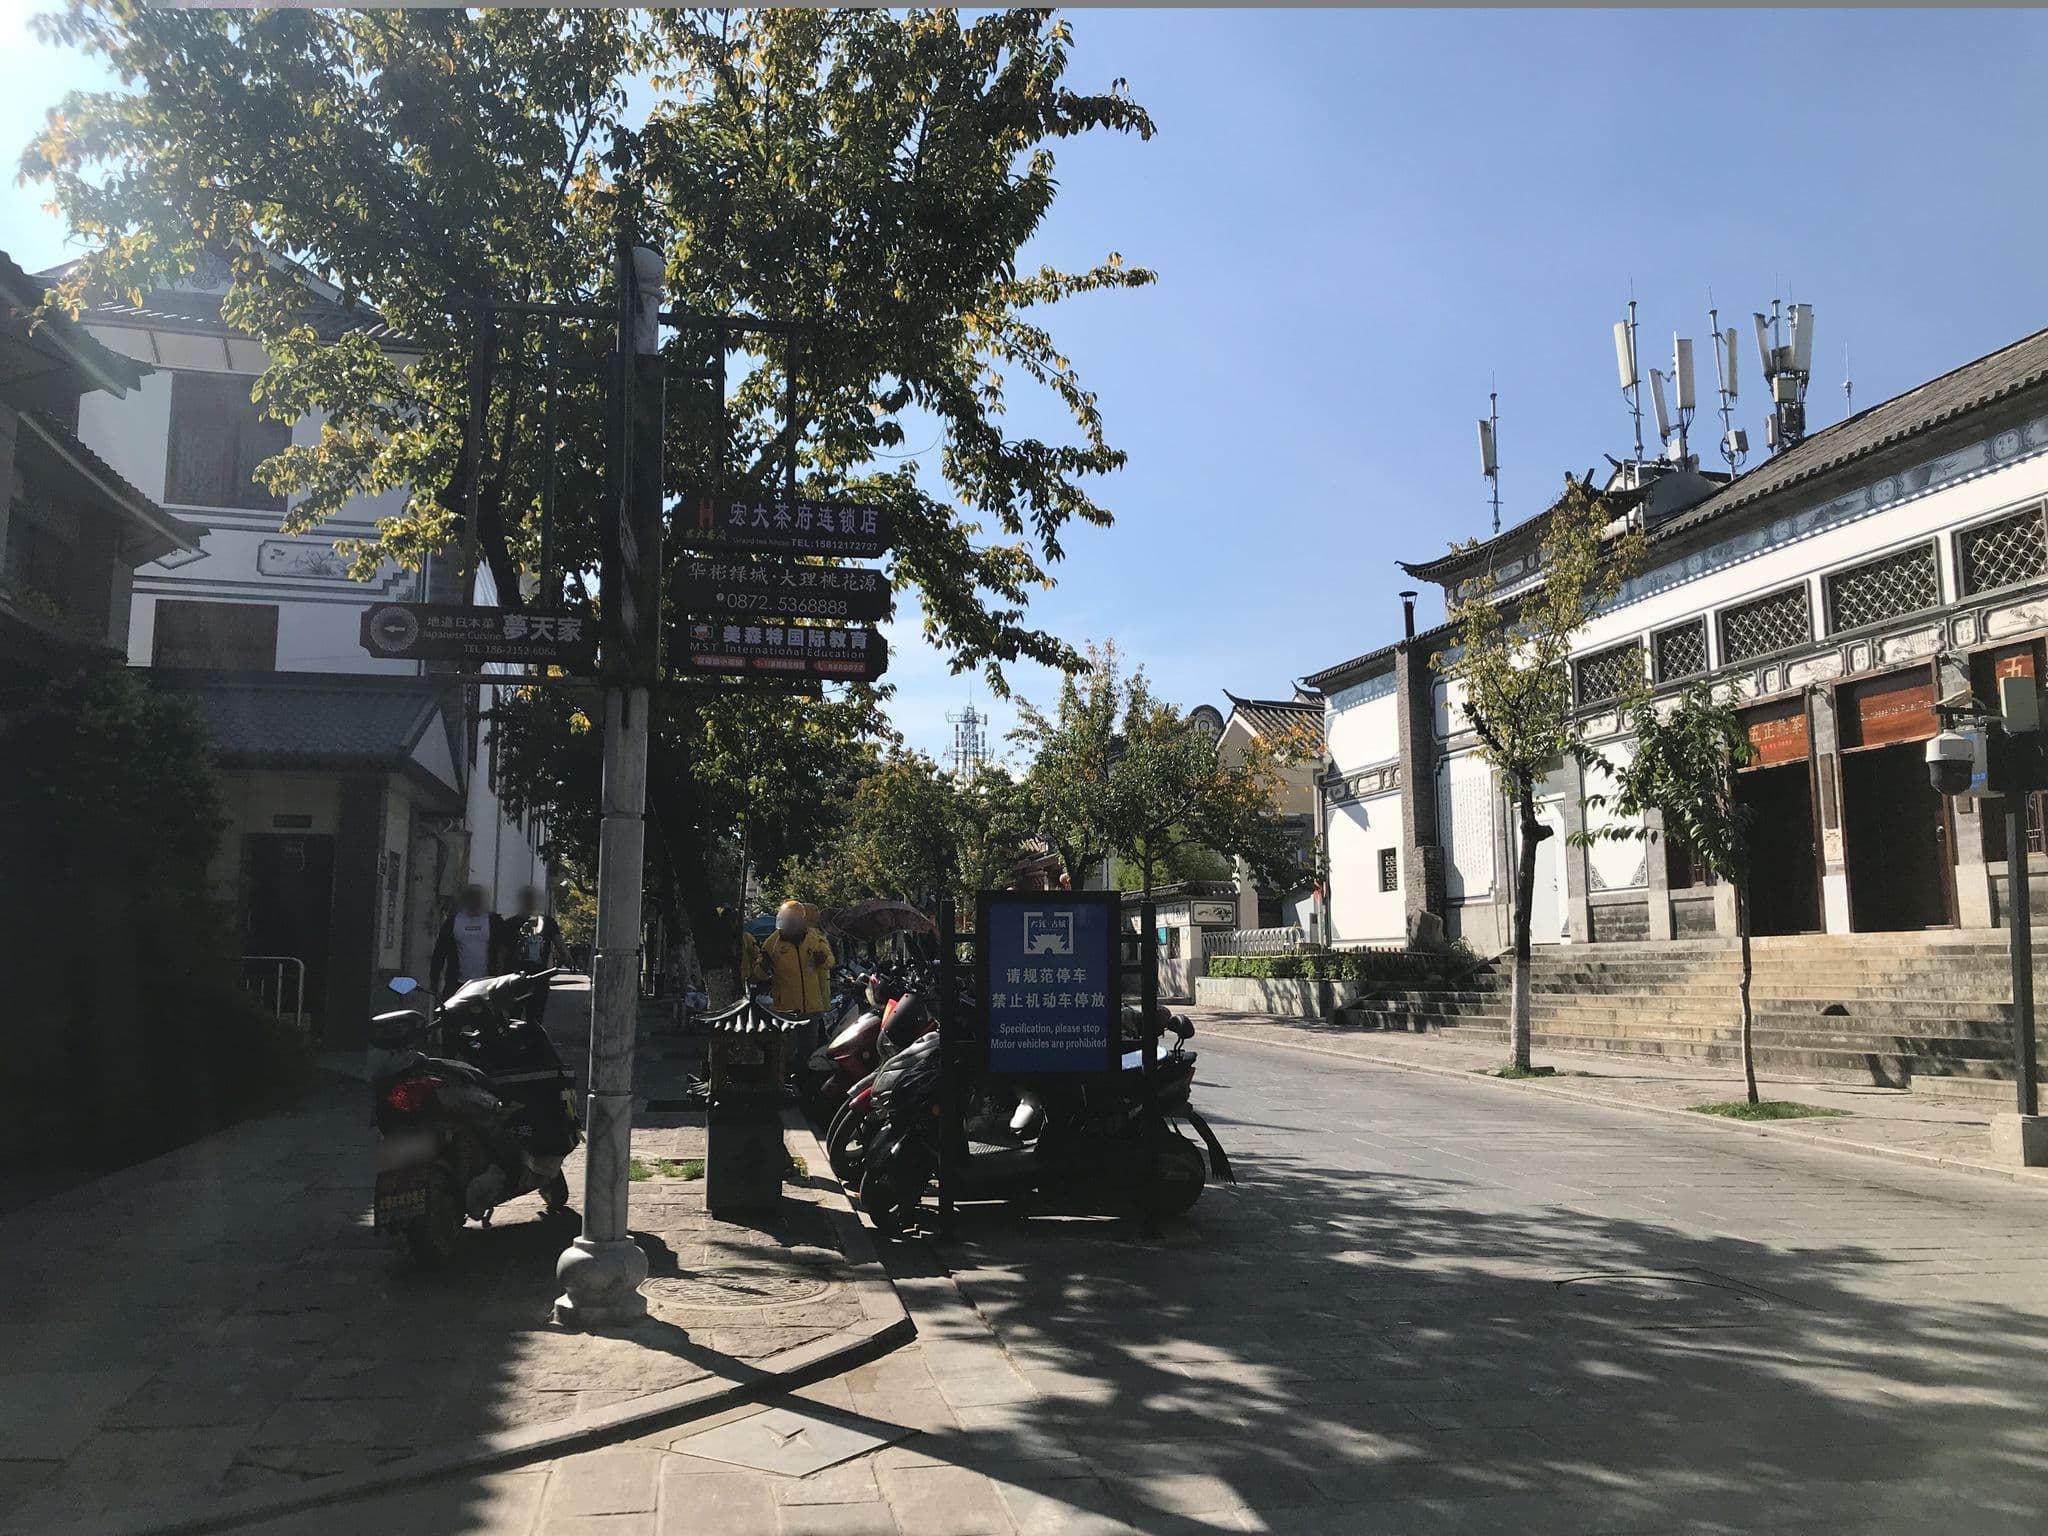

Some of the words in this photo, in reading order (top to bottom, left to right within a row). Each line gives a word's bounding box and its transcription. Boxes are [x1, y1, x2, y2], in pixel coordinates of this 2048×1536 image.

[728, 501, 879, 535] 宏大茶府连锁店
[503, 613, 583, 642] 夢天家
[725, 644, 804, 657] International
[807, 648, 866, 660] Education
[1006, 967, 1088, 984] 请规范停车
[991, 992, 1107, 1009] 禁止机动车停放
[1055, 1022, 1081, 1036] please
[1082, 1024, 1101, 1036] stop
[990, 1038, 1016, 1049] Motor
[1017, 1038, 1050, 1049] vehicles
[1051, 1040, 1065, 1049] are
[1066, 1037, 1107, 1051] prohibited
